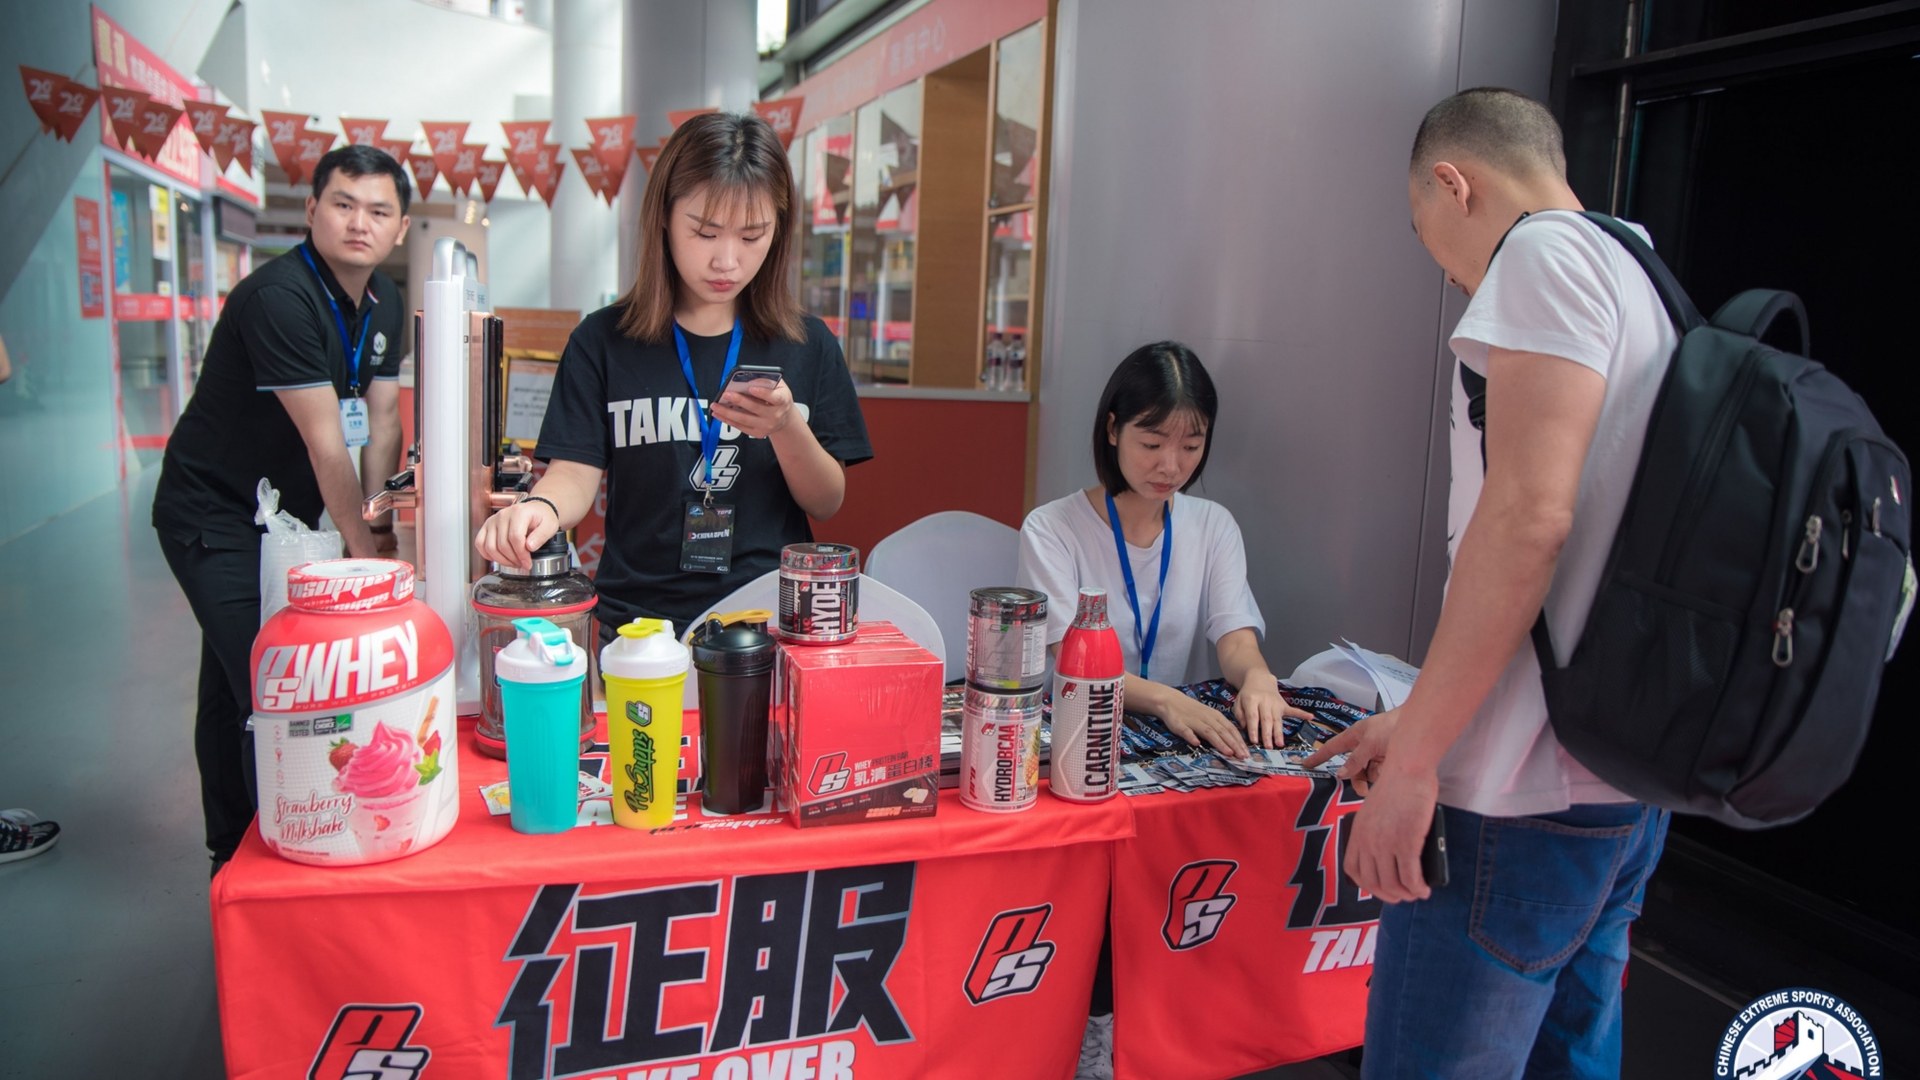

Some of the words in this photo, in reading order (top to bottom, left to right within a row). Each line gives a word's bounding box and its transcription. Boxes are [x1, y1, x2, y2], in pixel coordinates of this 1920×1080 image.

[811, 581, 841, 635] HYDE
[291, 619, 419, 705] WHEY
[854, 760, 872, 771] WHEY
[994, 723, 1016, 802] HYDROBCAA
[275, 790, 352, 824] Strawberry
[281, 814, 344, 841] Milkshake
[489, 861, 918, 1080] 征服
